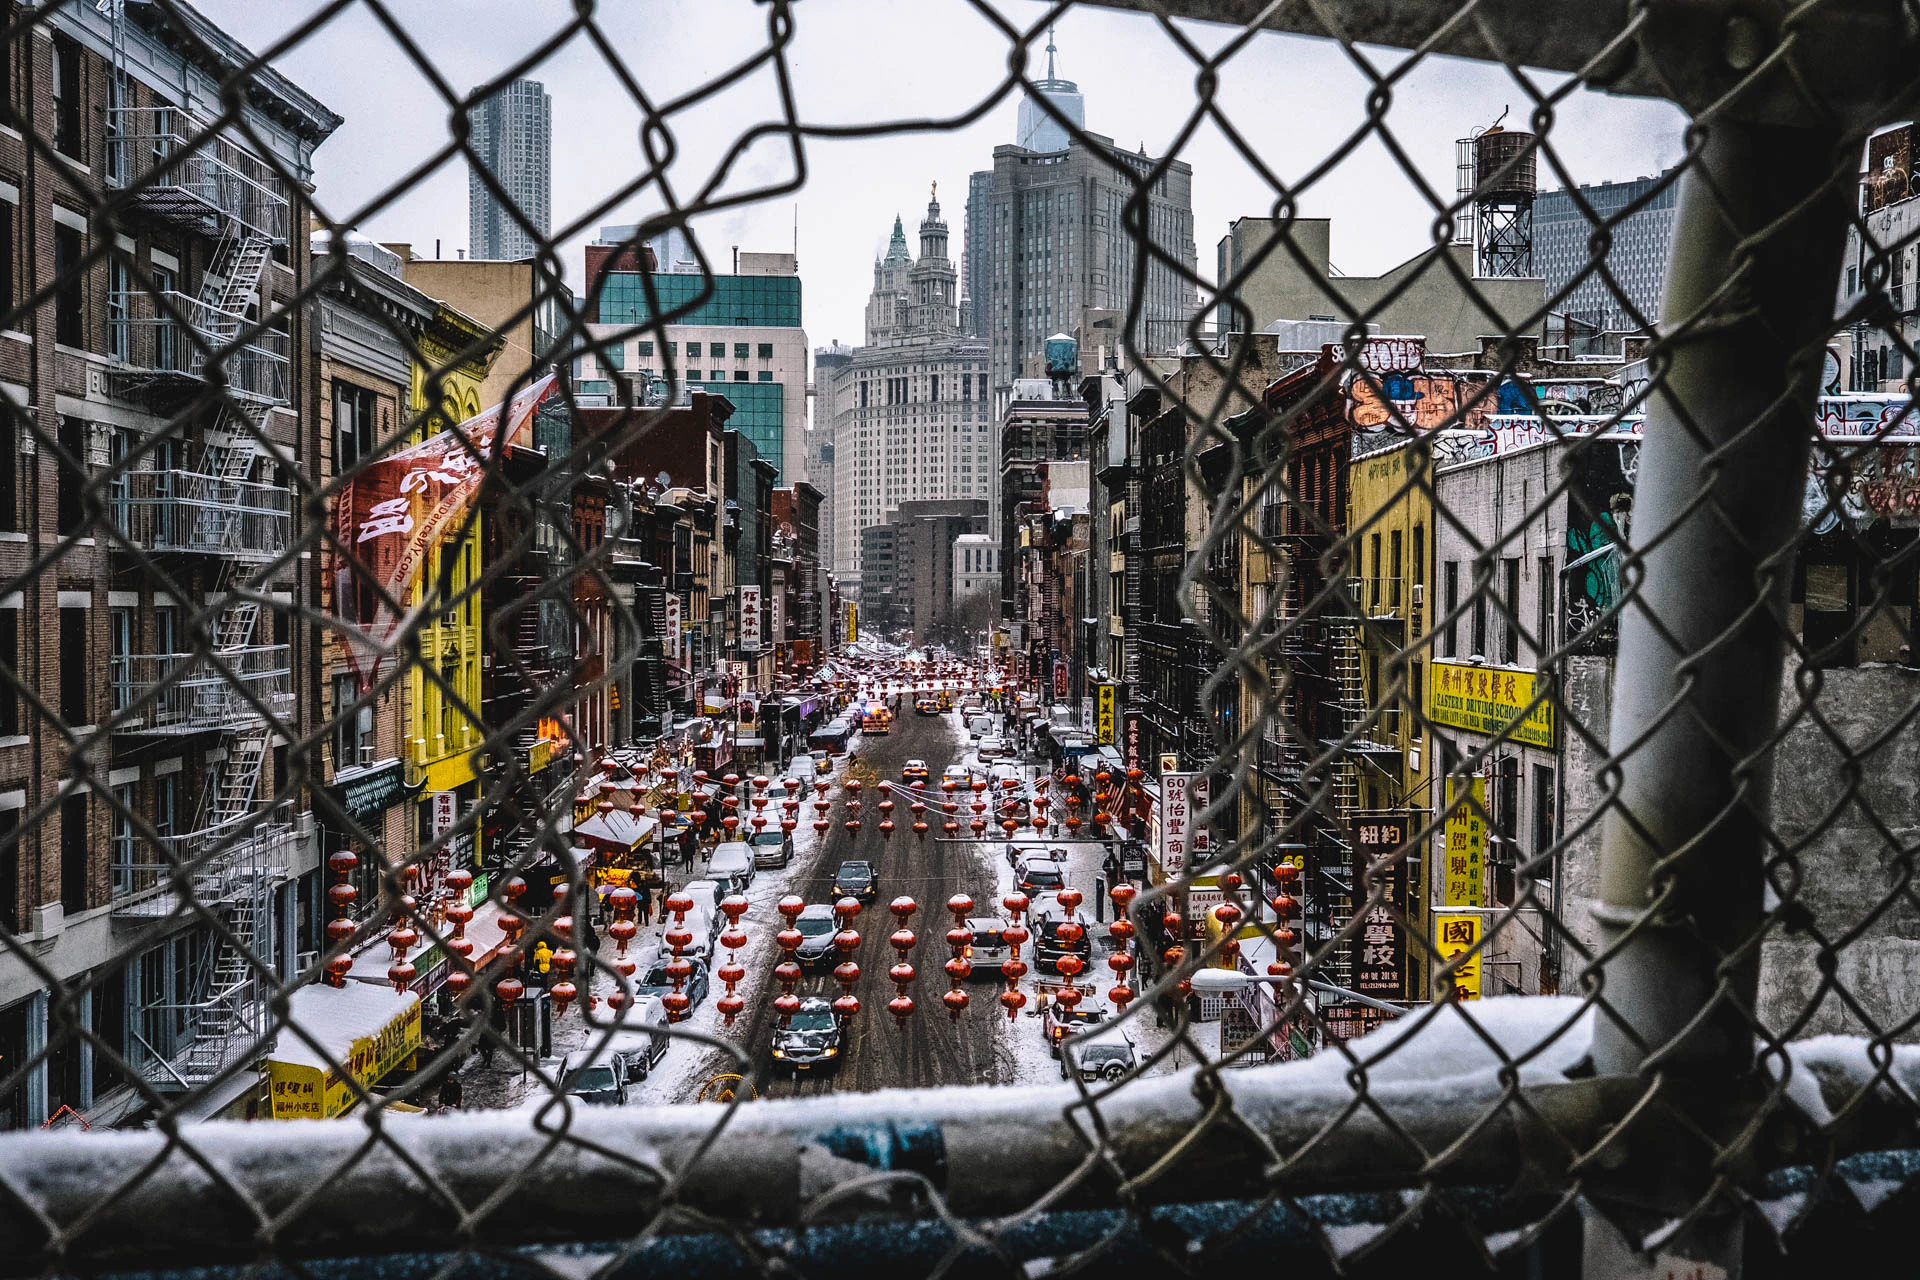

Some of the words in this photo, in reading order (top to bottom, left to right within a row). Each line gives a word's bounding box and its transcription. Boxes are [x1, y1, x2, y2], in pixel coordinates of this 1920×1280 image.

[1440, 667, 1516, 703] 廣州駕駛學校
[1436, 693, 1464, 711] EASTERN
[1466, 698, 1494, 719] DRIVING
[1360, 825, 1400, 845] 紐約
